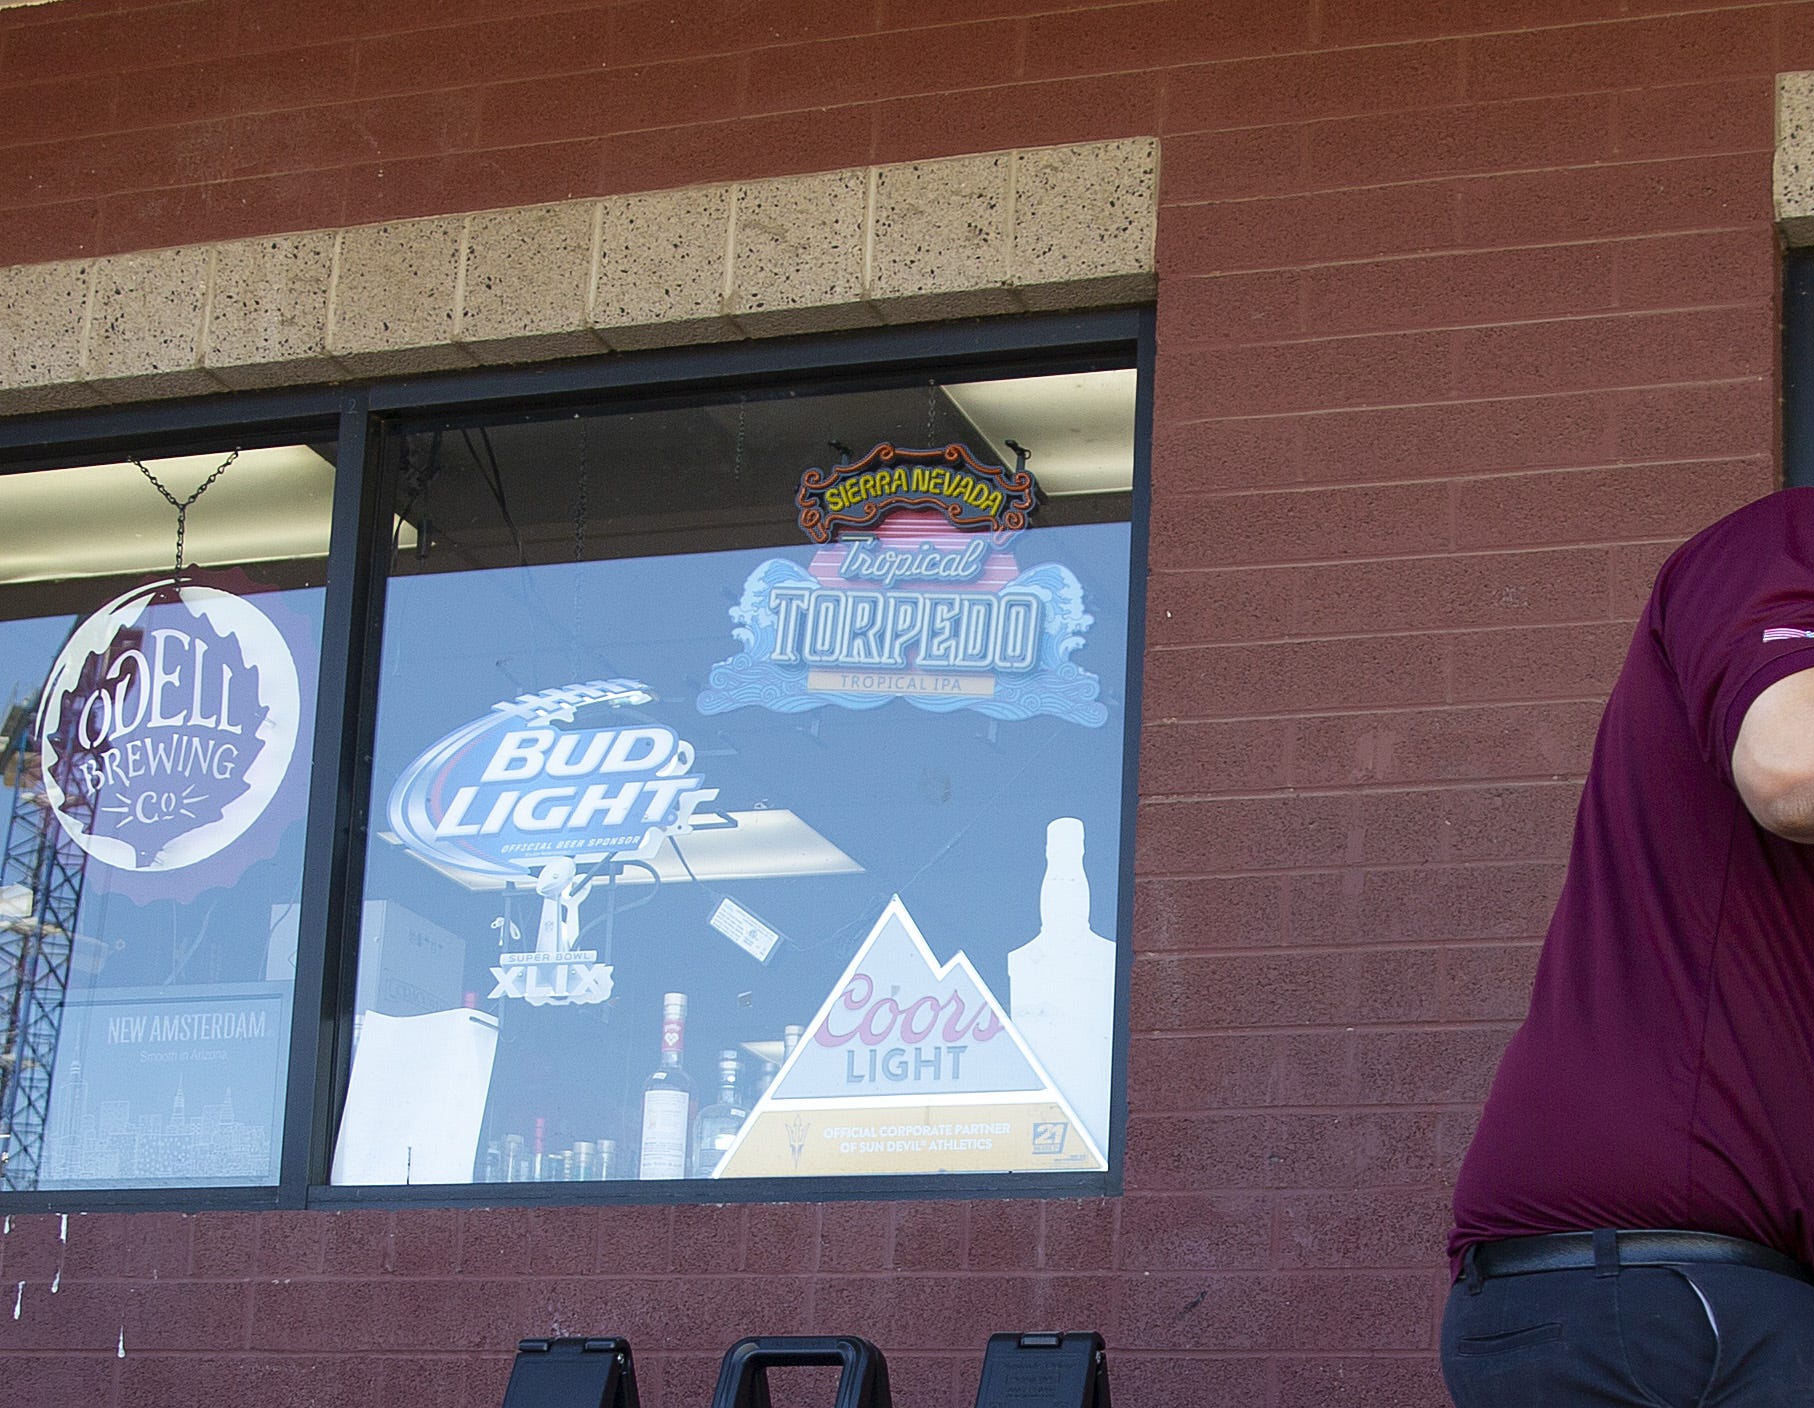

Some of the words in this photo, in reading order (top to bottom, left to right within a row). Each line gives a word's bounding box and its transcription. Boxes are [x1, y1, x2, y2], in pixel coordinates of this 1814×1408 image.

[825, 468, 908, 512] SIERRA
[911, 467, 1004, 517] NEVADA
[840, 536, 984, 586] Tropical
[768, 588, 1038, 667] TORPEDO
[78, 629, 242, 749] ODELL
[841, 675, 927, 691] TROPICAL
[933, 676, 962, 692] IPA
[79, 734, 238, 795] BREWING
[480, 727, 674, 782] BUD
[434, 777, 700, 837] LIGHT
[501, 842, 552, 853] OFFICIAL
[556, 839, 584, 849] BEER
[587, 835, 640, 847] SPONSOR
[509, 953, 550, 962] SUPER
[556, 952, 591, 961] BOWL
[488, 963, 607, 999] XLIX
[107, 1015, 147, 1044] NEW
[150, 1010, 266, 1042] AMSTERDAM
[813, 973, 1005, 1047] Coors
[846, 1045, 968, 1084] LIGHT
[823, 1125, 877, 1139] OFFICIAL
[879, 1123, 951, 1138] CORPORATE
[953, 1122, 1011, 1135] PARTNER
[840, 1141, 859, 1153] OF
[859, 1140, 885, 1152] SUN
[929, 1138, 993, 1151] ATHLETICS
